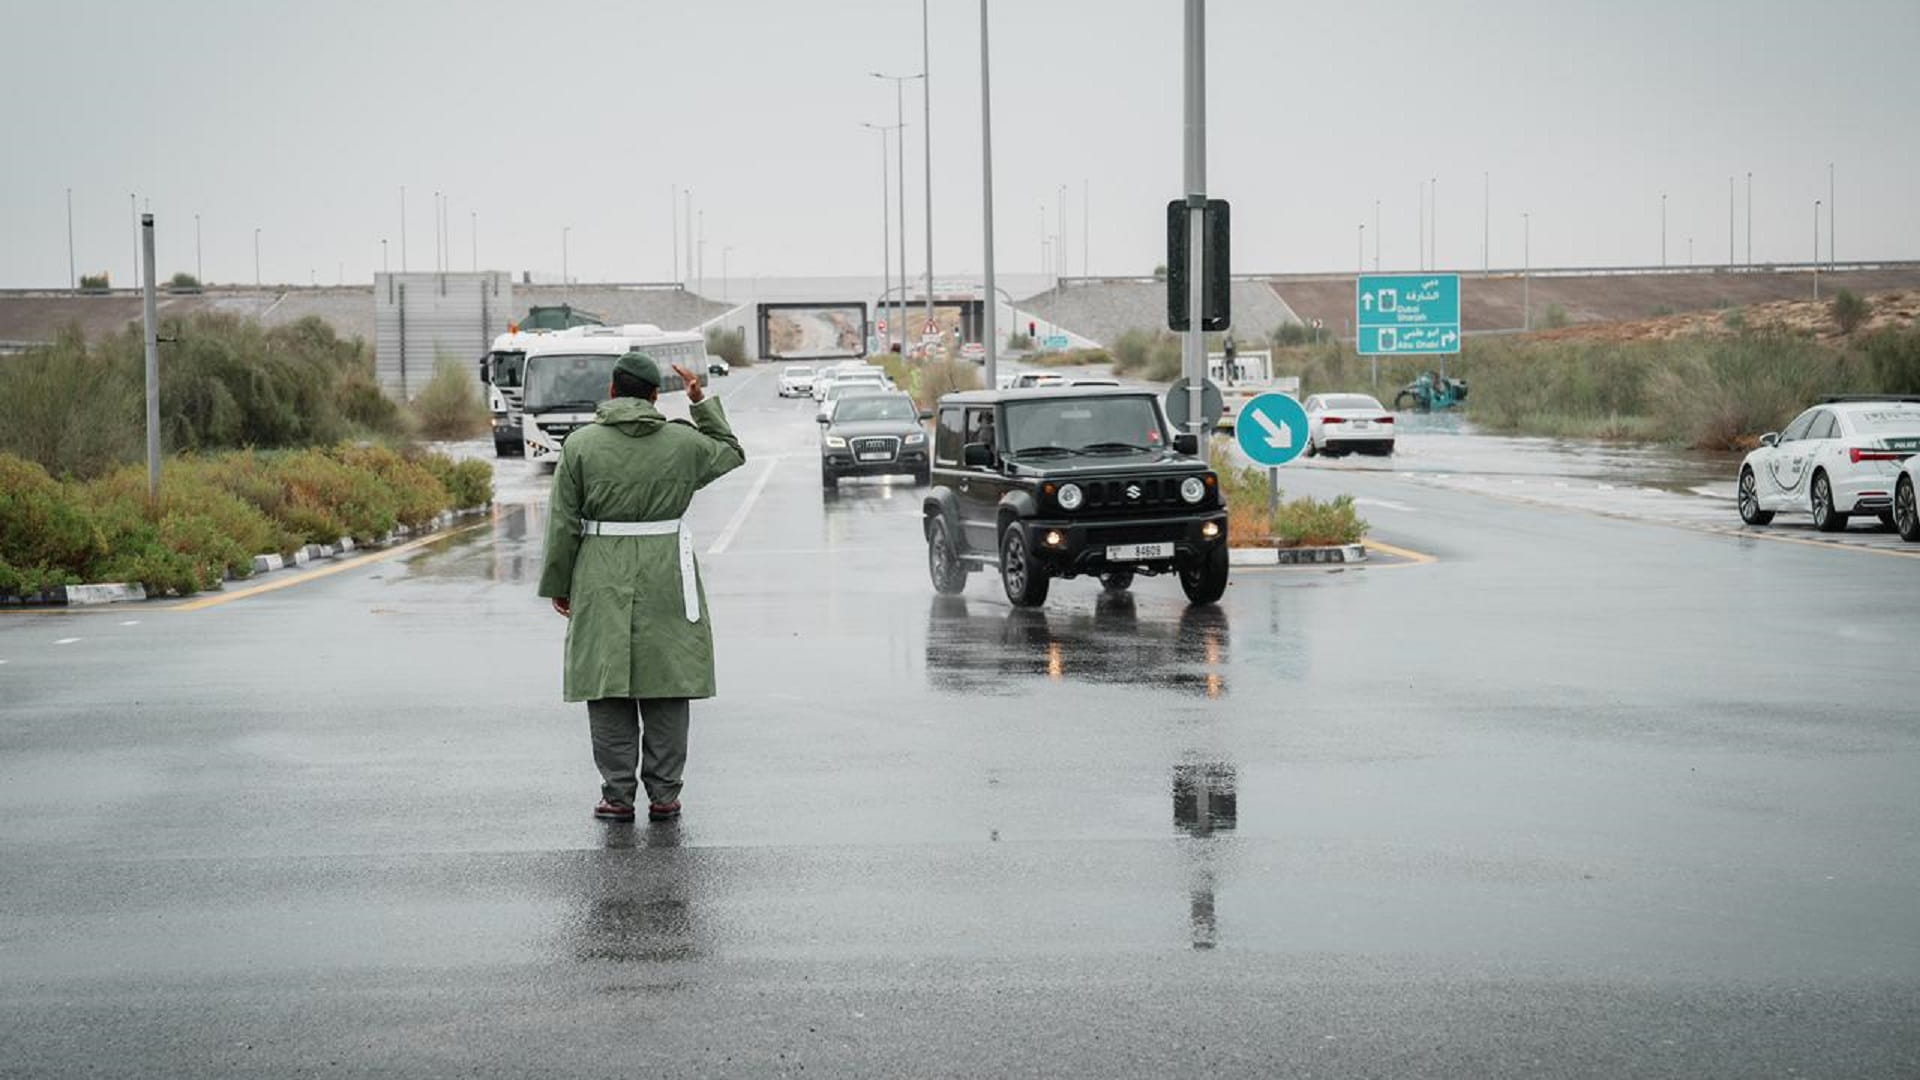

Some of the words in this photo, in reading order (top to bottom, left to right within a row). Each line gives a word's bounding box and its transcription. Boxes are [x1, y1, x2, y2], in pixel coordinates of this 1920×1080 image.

[1397, 304, 1420, 313] Dubai
[1398, 340, 1414, 349] Abu
[1415, 340, 1439, 349] Dhabi
